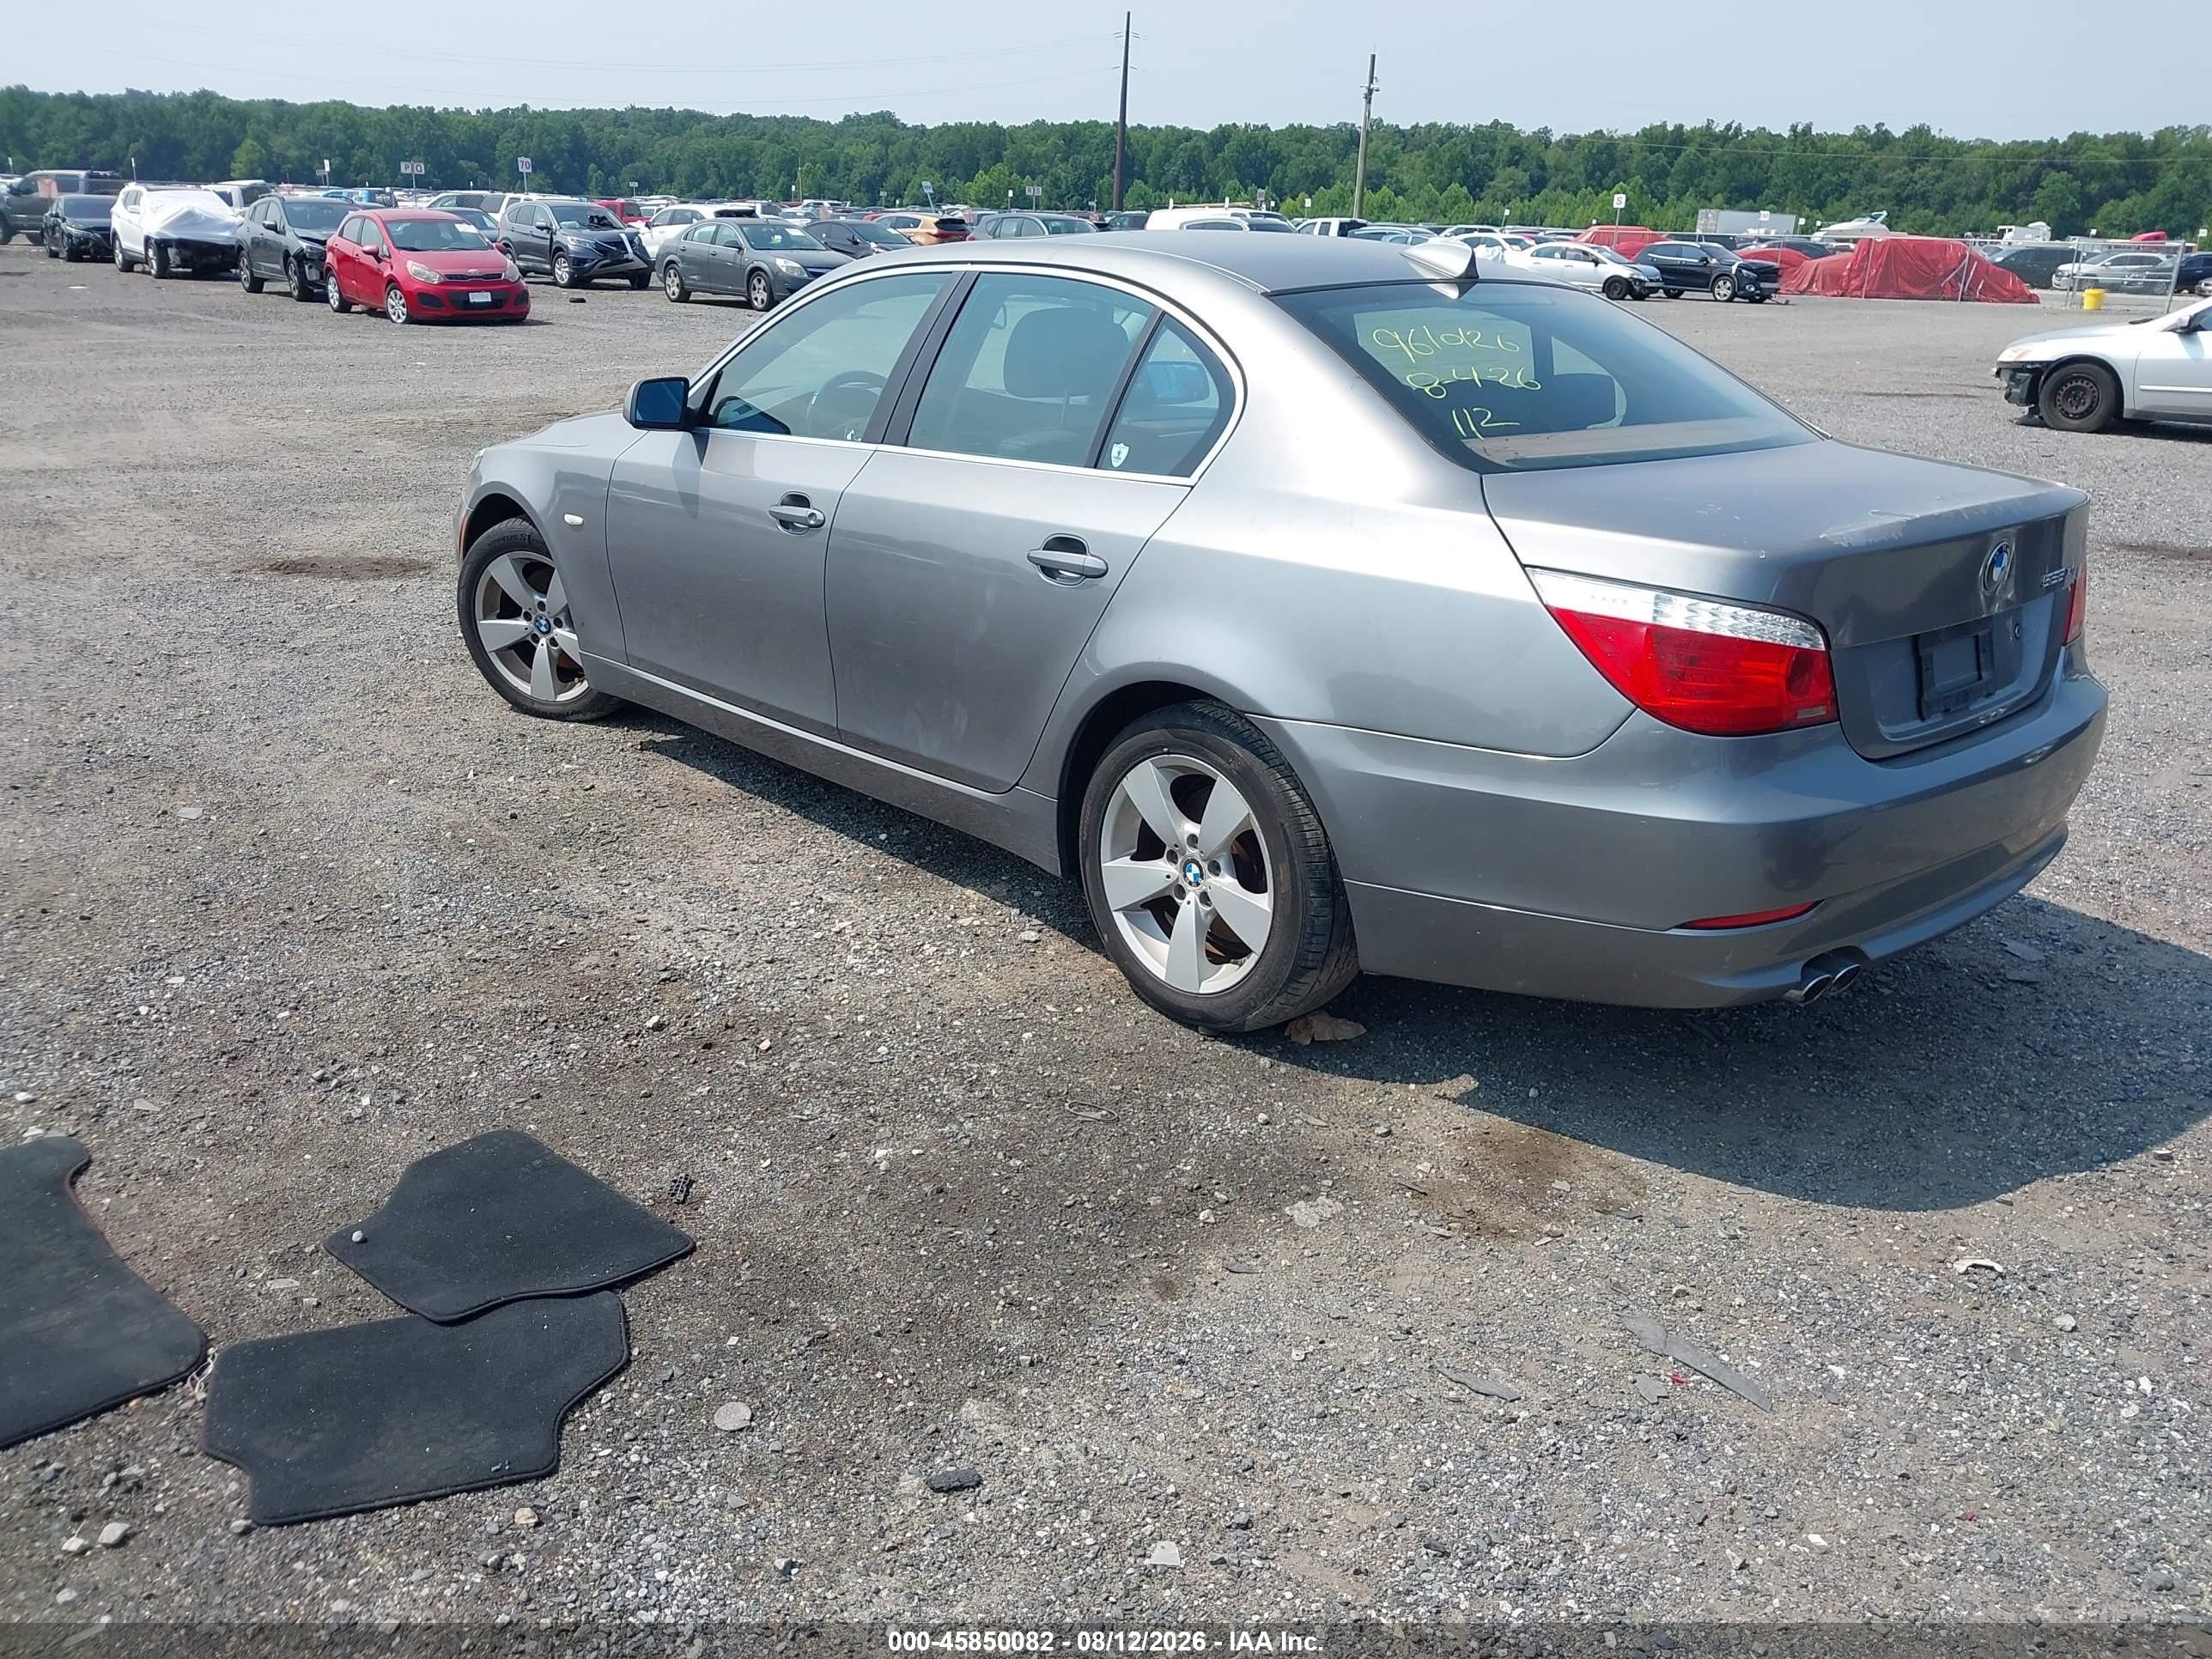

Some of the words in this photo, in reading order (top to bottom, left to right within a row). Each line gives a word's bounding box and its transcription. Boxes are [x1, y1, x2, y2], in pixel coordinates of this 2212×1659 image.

[416, 164, 422, 173] Q
[520, 160, 531, 170] 70
[1616, 197, 1623, 205] S
[1451, 407, 1521, 441] 112
